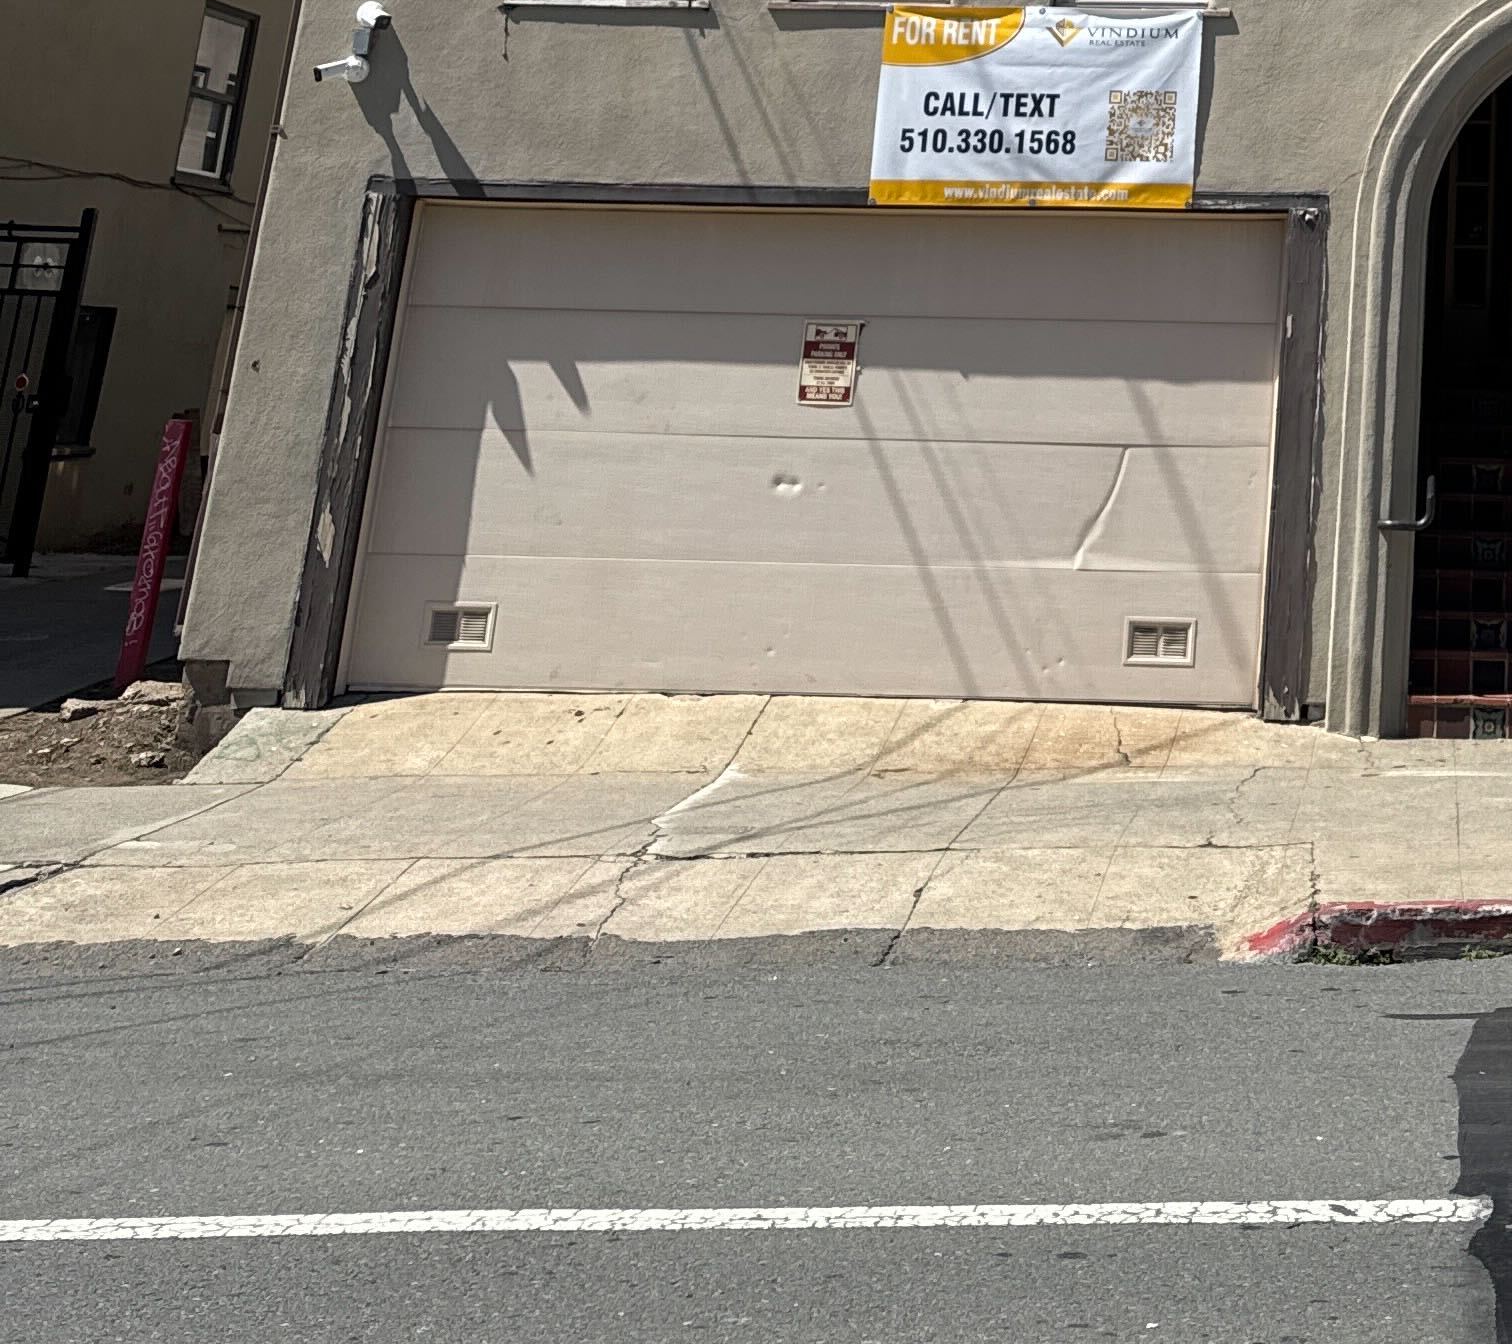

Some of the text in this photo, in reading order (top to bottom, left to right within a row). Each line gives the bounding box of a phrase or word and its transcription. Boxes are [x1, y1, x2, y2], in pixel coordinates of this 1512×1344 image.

[892, 16, 999, 46] FOR RENT
[1087, 26, 1179, 39] VINDIUM
[923, 91, 1061, 119] CALL/TEXT
[899, 127, 1077, 155] 510.330.1568
